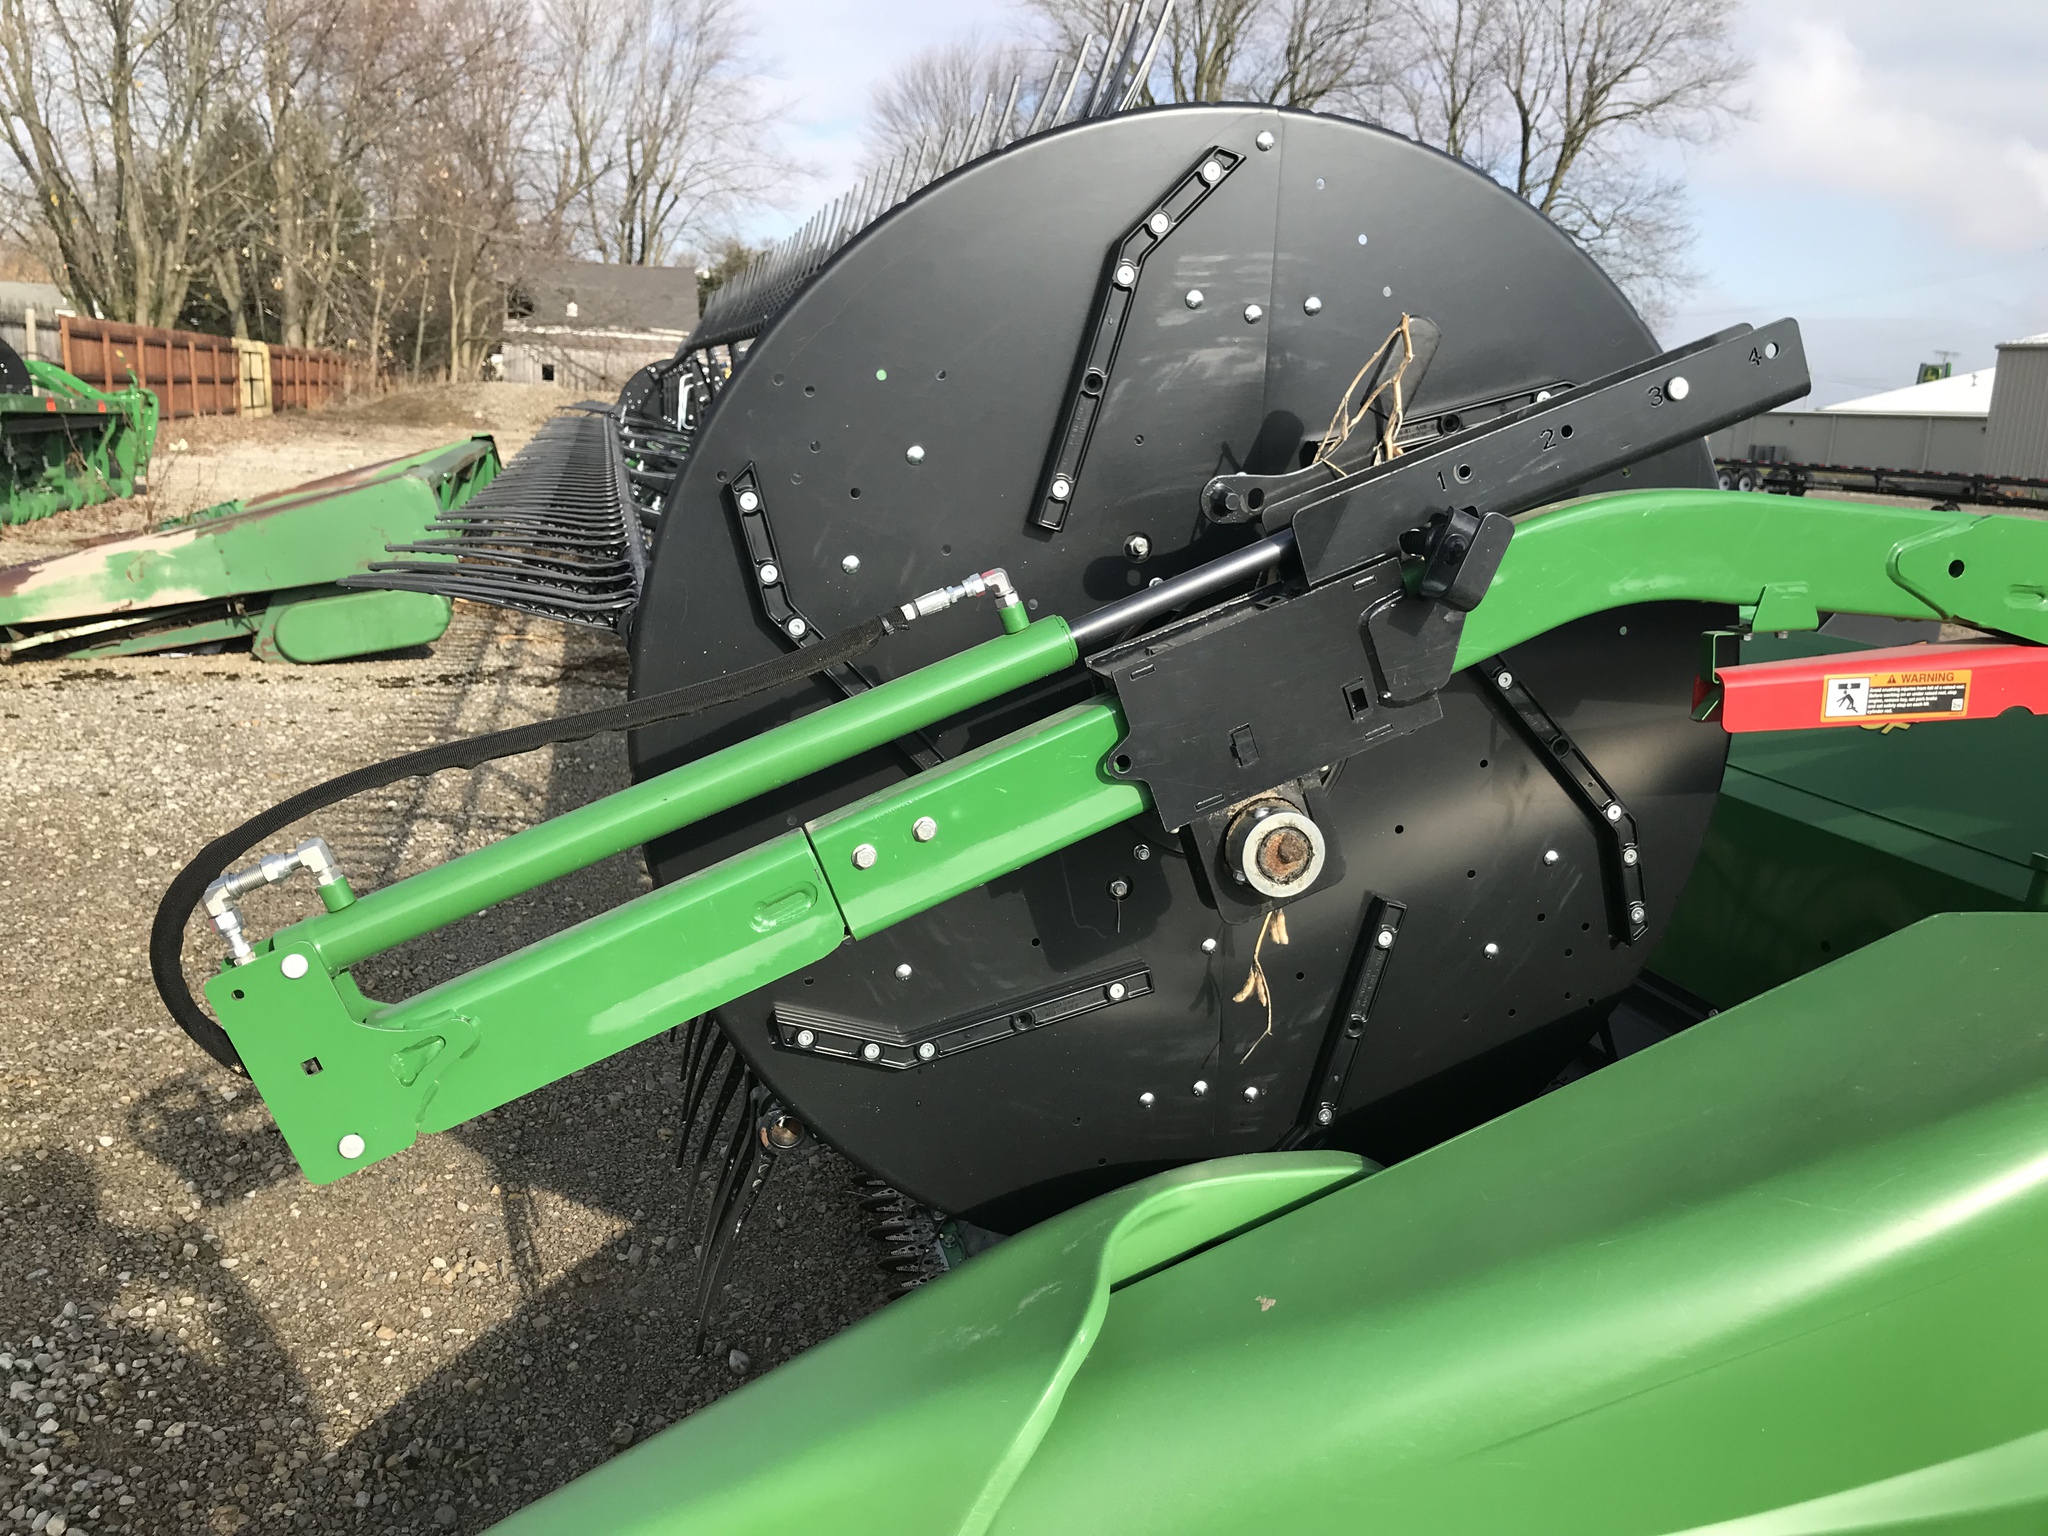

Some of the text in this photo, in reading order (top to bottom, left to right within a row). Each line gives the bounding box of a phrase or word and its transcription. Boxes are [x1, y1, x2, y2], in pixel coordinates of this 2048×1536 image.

[1748, 347, 1762, 366] 4
[1648, 386, 1664, 408] 3
[1539, 428, 1557, 451] 2
[1436, 470, 1447, 492] 1
[1901, 672, 1954, 683] WARNING
